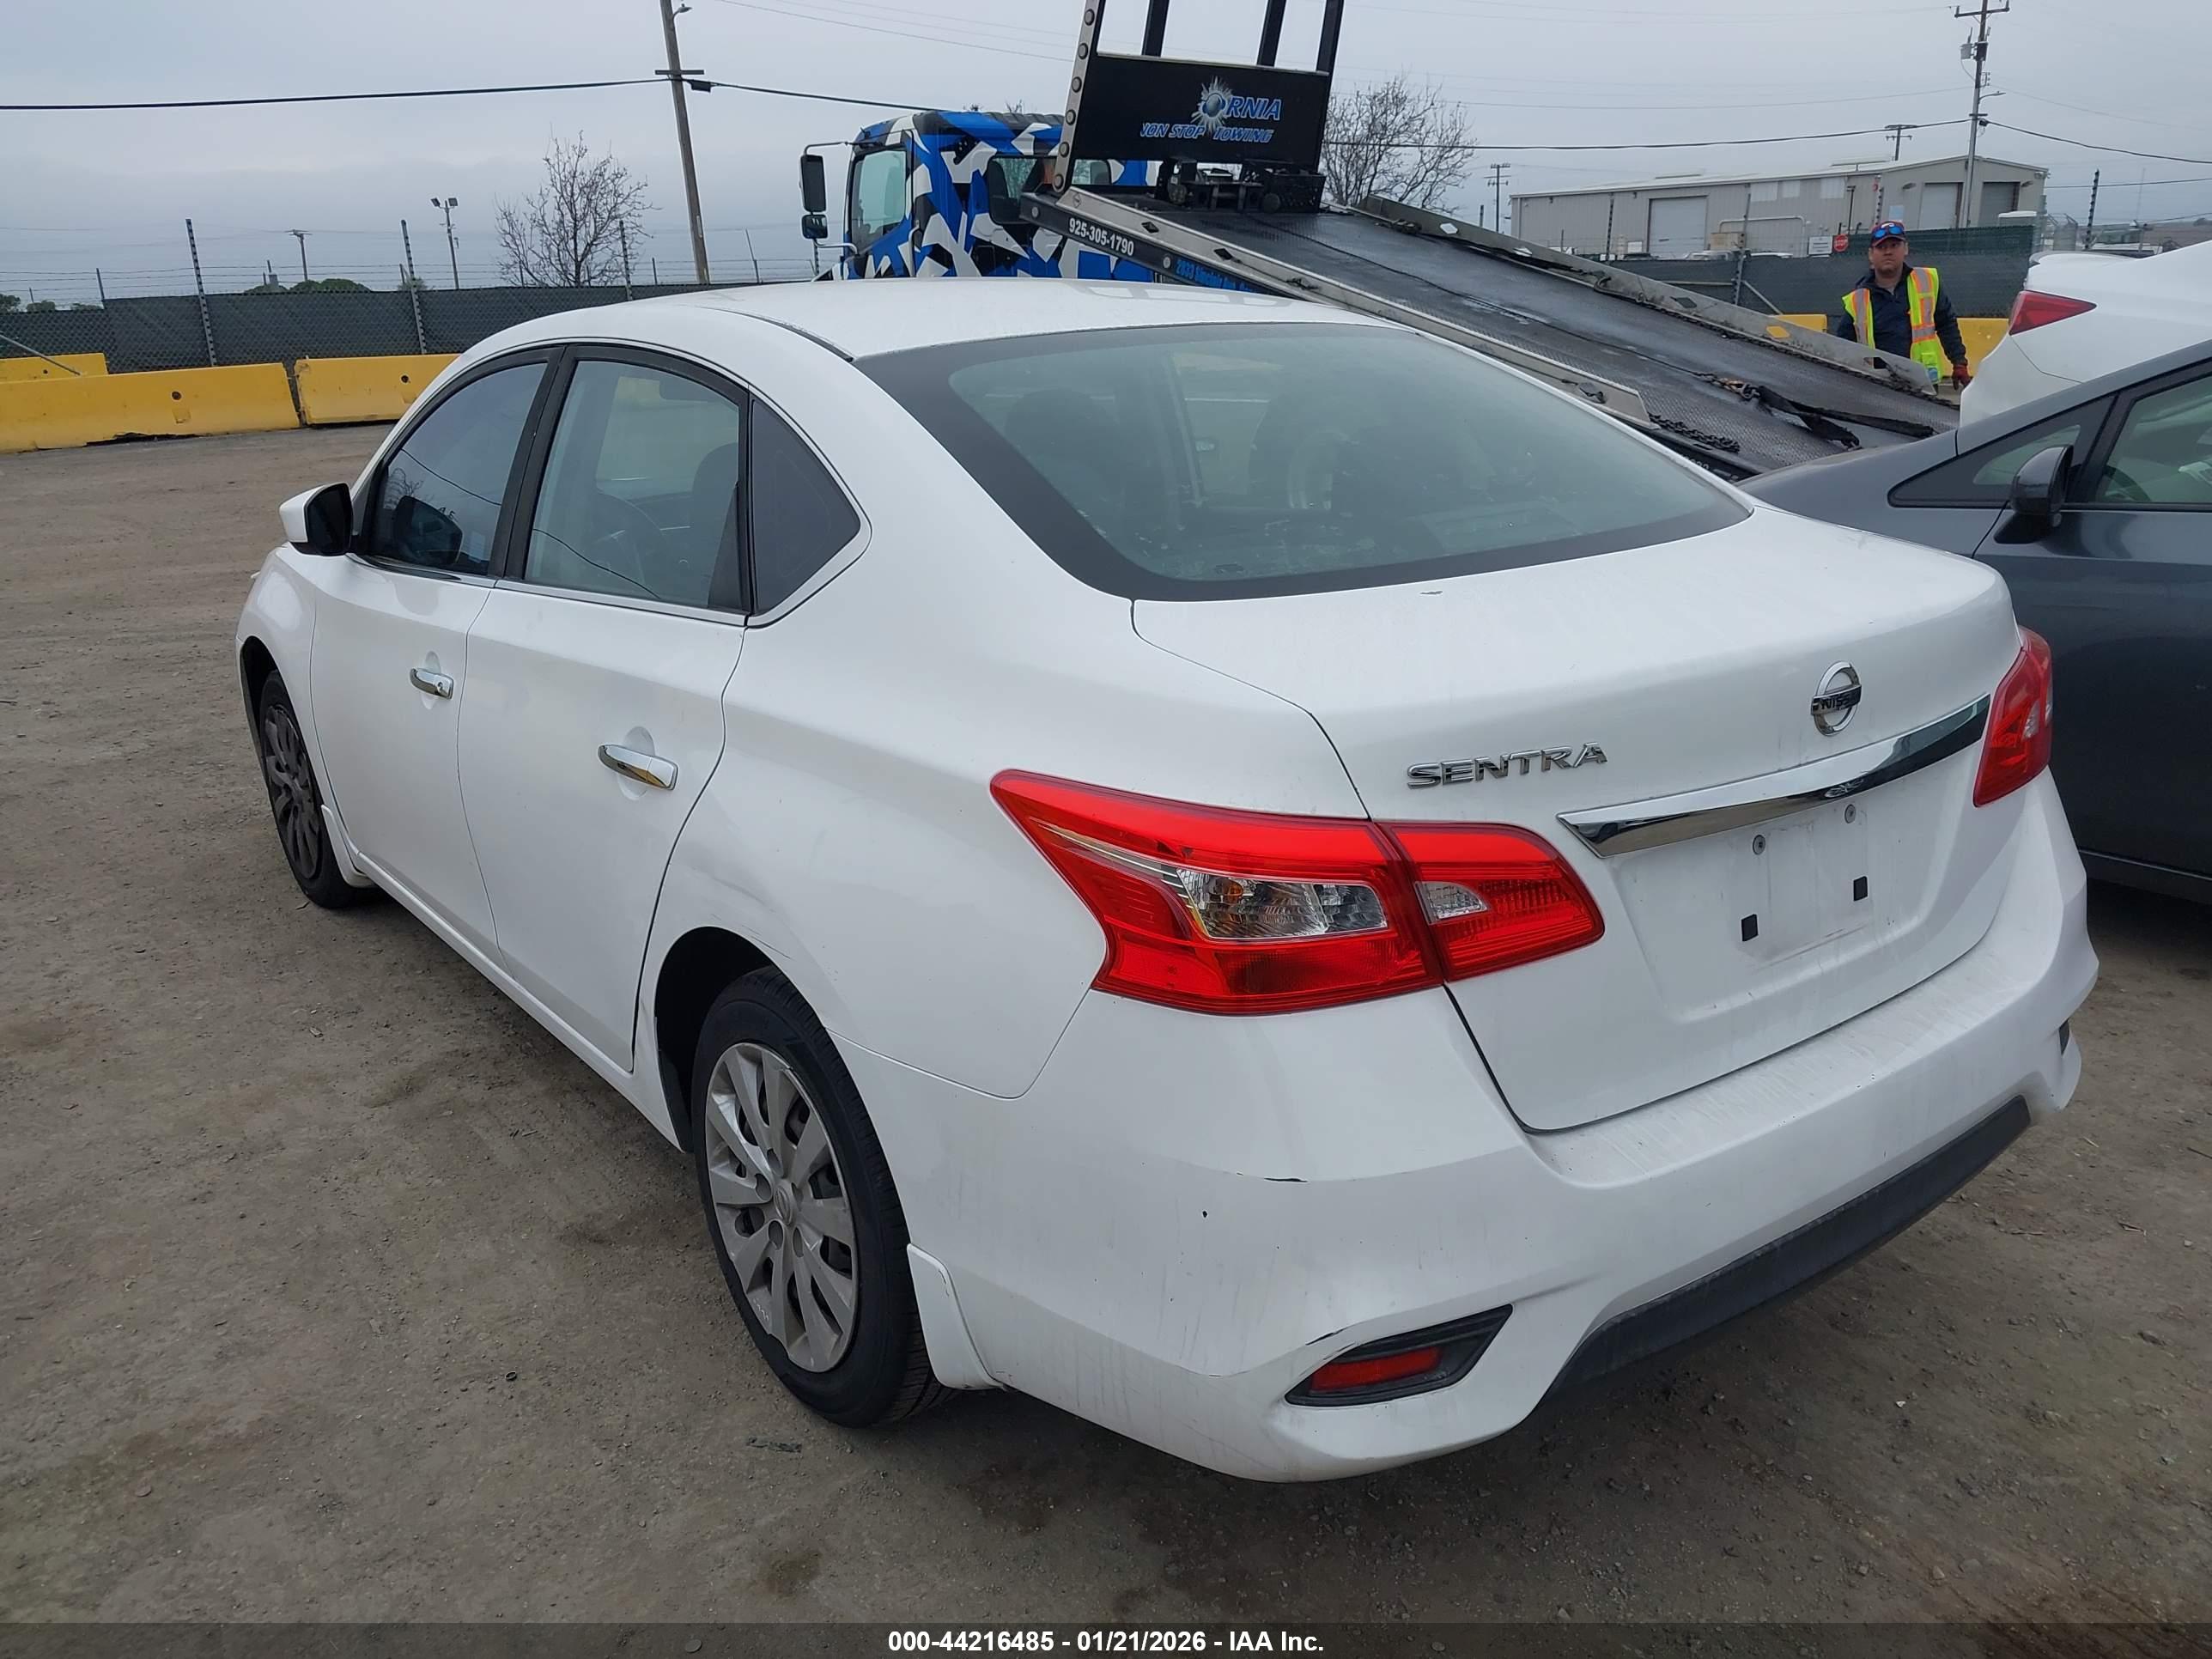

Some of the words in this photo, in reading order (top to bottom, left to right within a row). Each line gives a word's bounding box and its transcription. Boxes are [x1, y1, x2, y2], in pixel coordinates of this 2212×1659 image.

[1168, 124, 1206, 140] STOP
[1212, 126, 1275, 143] TOWING
[1069, 217, 1134, 256] 925-305-1790
[1407, 741, 1608, 790] SENTRA
